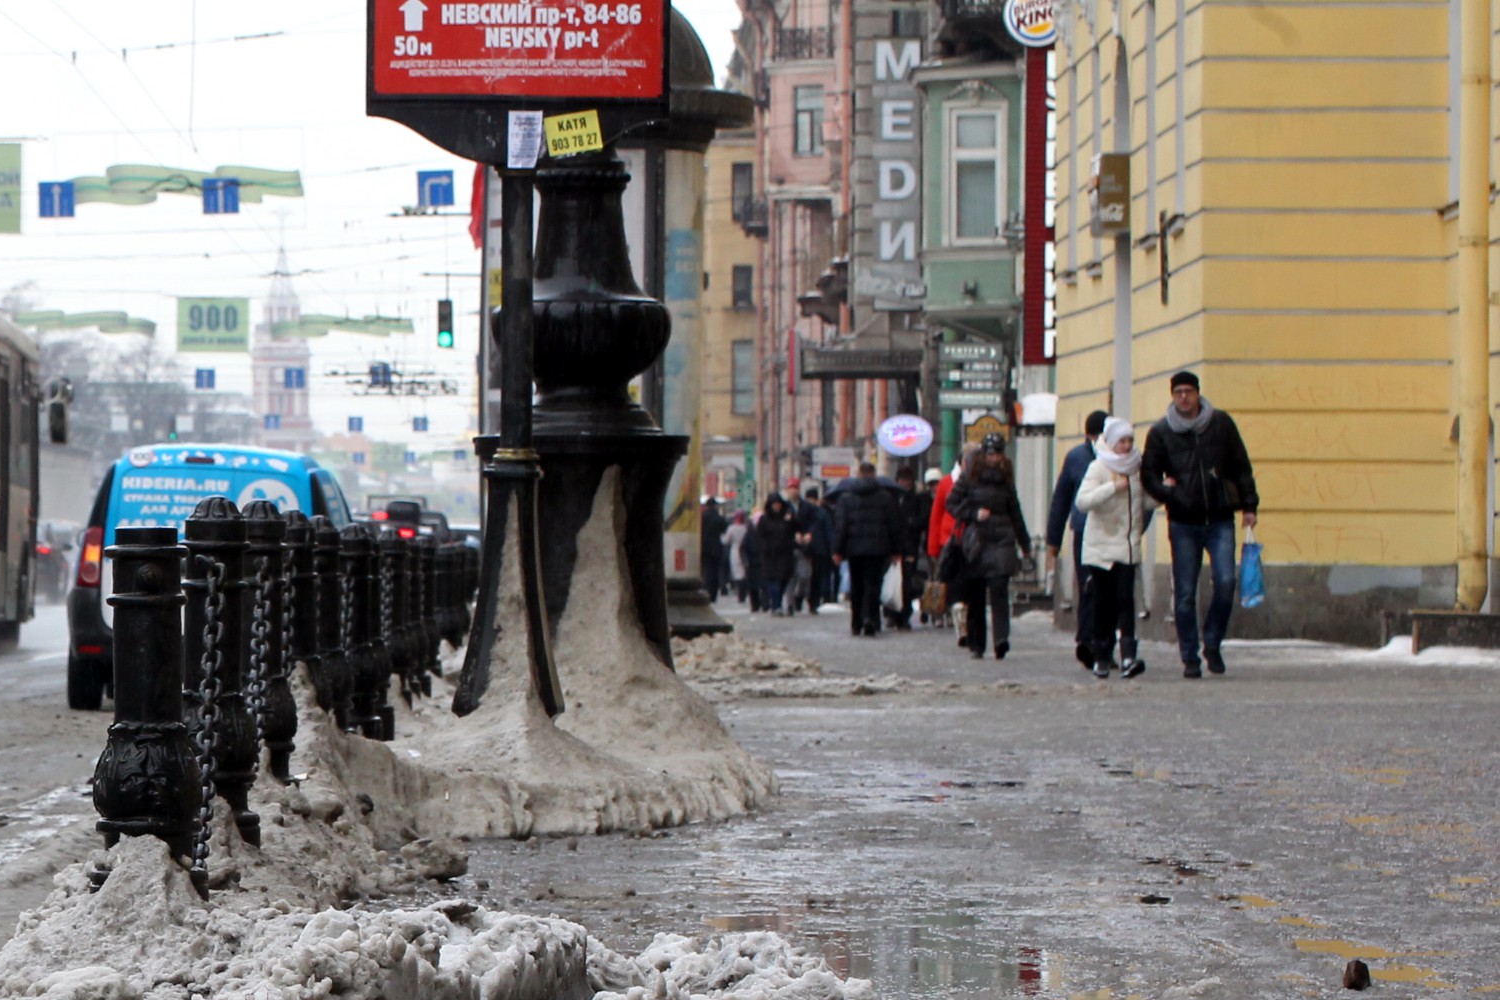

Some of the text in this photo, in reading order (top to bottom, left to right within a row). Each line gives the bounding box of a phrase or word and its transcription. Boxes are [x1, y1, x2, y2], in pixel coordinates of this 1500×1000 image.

[441, 0, 641, 27] НЕВСКИЙ пр-т, 84-86
[485, 27, 599, 49] NEVSKY pr-t
[557, 116, 587, 132] КАТЯ
[551, 132, 598, 151] 903 78 27
[189, 304, 238, 332] 900
[122, 476, 230, 493] KIDERIA.RU
[140, 504, 168, 515] ДЛЯ
